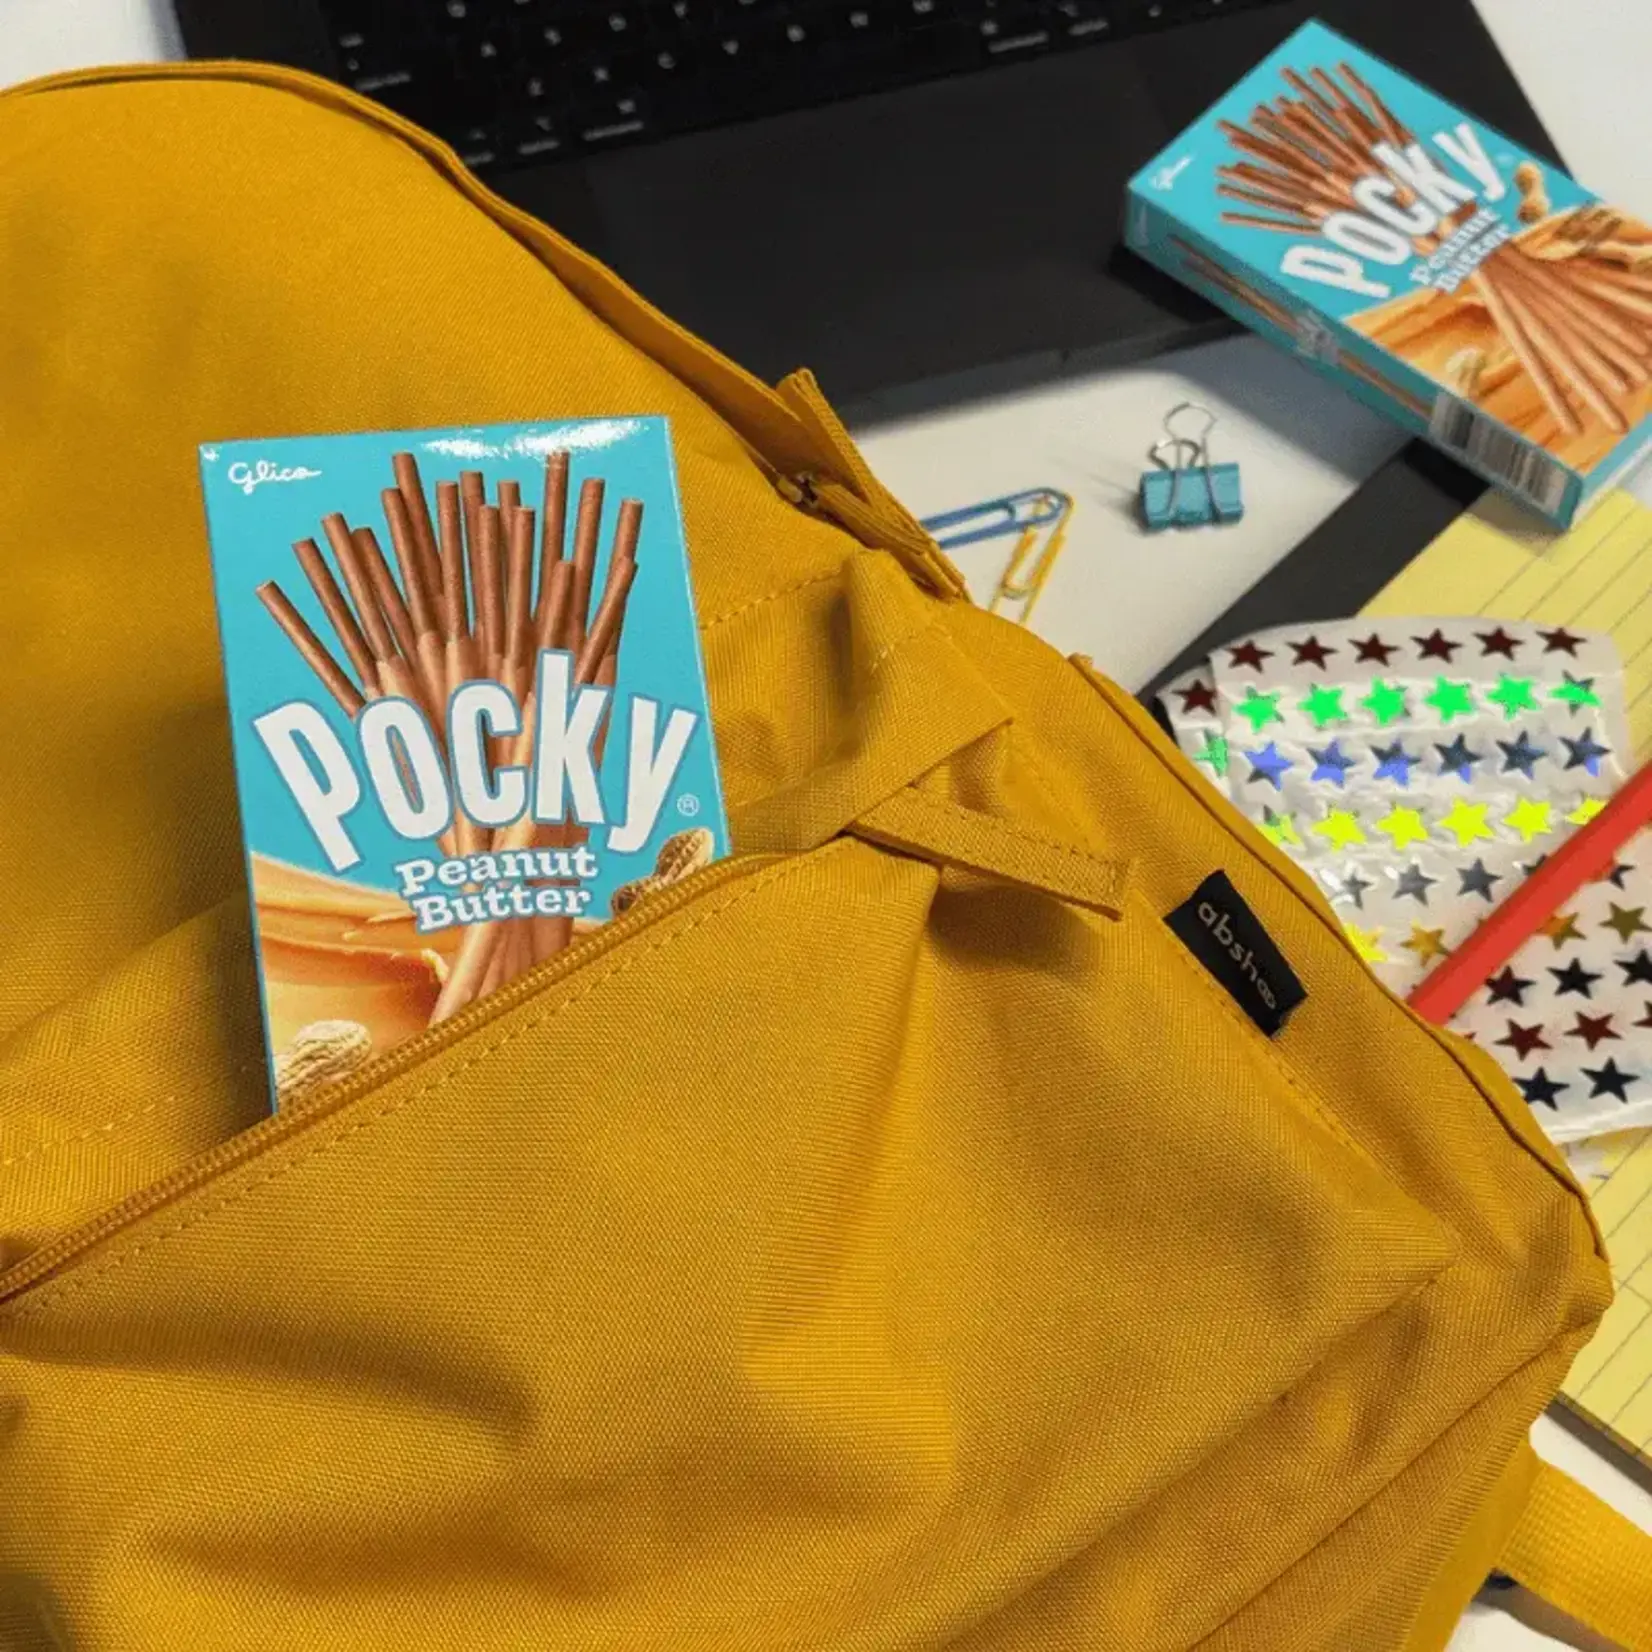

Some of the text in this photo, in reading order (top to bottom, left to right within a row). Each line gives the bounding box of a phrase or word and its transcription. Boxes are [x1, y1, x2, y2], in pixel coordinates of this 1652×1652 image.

[227, 459, 322, 496] Glico
[395, 846, 598, 897] Peanut
[412, 884, 592, 931] Butter
